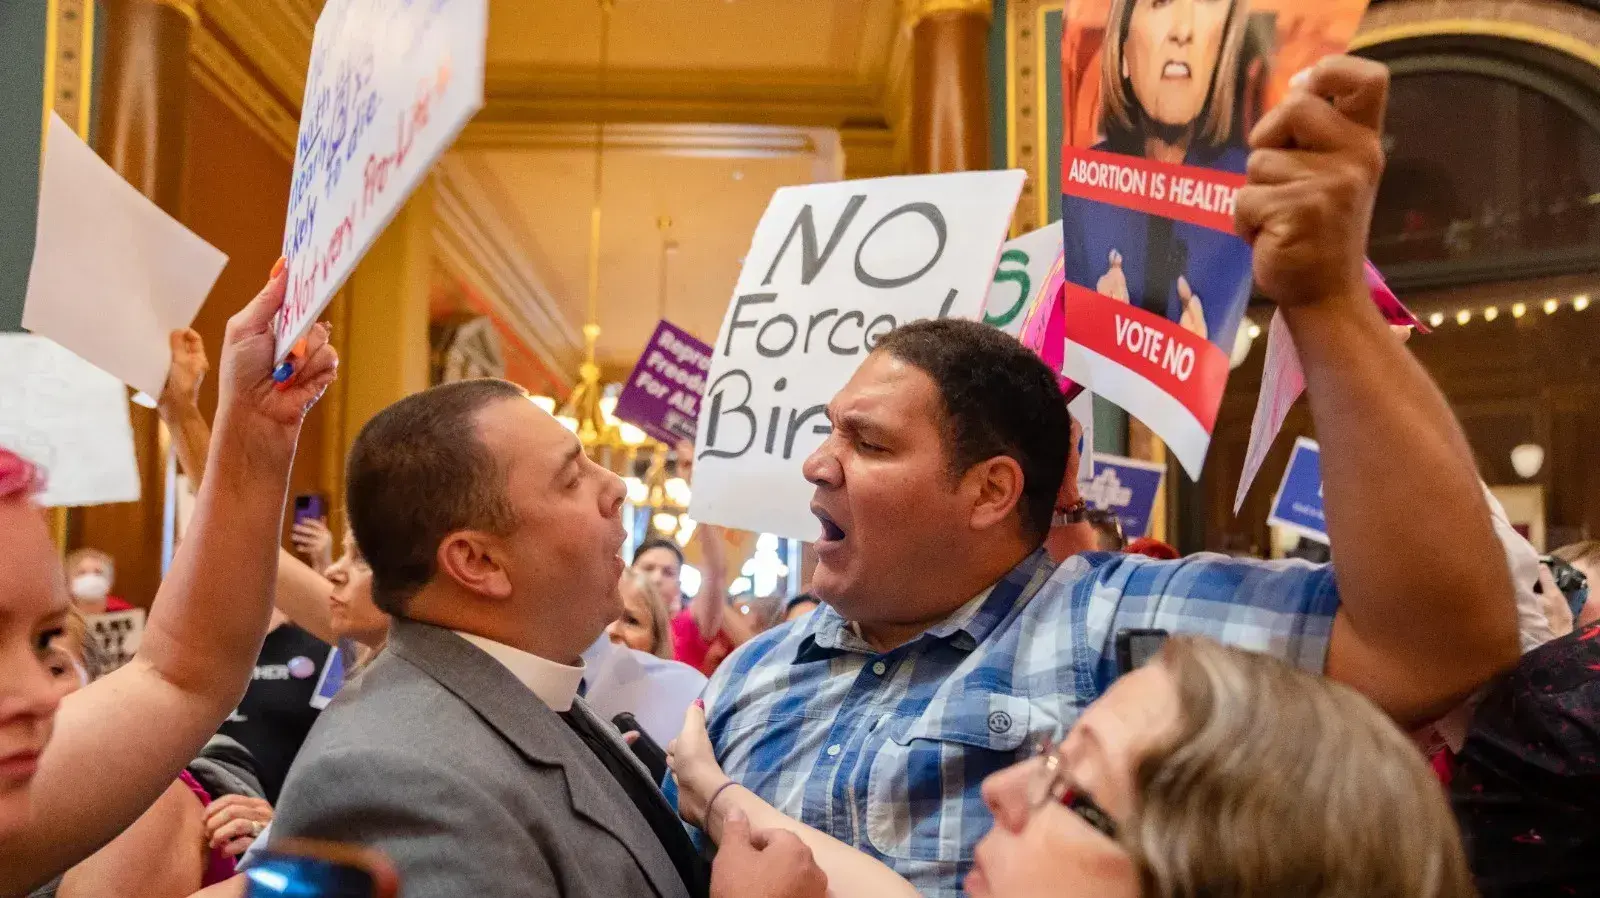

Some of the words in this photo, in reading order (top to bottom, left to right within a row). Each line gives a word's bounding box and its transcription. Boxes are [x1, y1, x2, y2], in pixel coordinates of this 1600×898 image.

[1068, 157, 1147, 196] ABORTION
[1150, 172, 1167, 201] IS
[1169, 175, 1239, 216] HEALTH
[322, 202, 356, 281] very
[761, 194, 948, 289] NO
[1115, 313, 1164, 364] VOTE
[1162, 337, 1196, 382] NO
[635, 371, 670, 399] For
[699, 369, 830, 459] Bir
